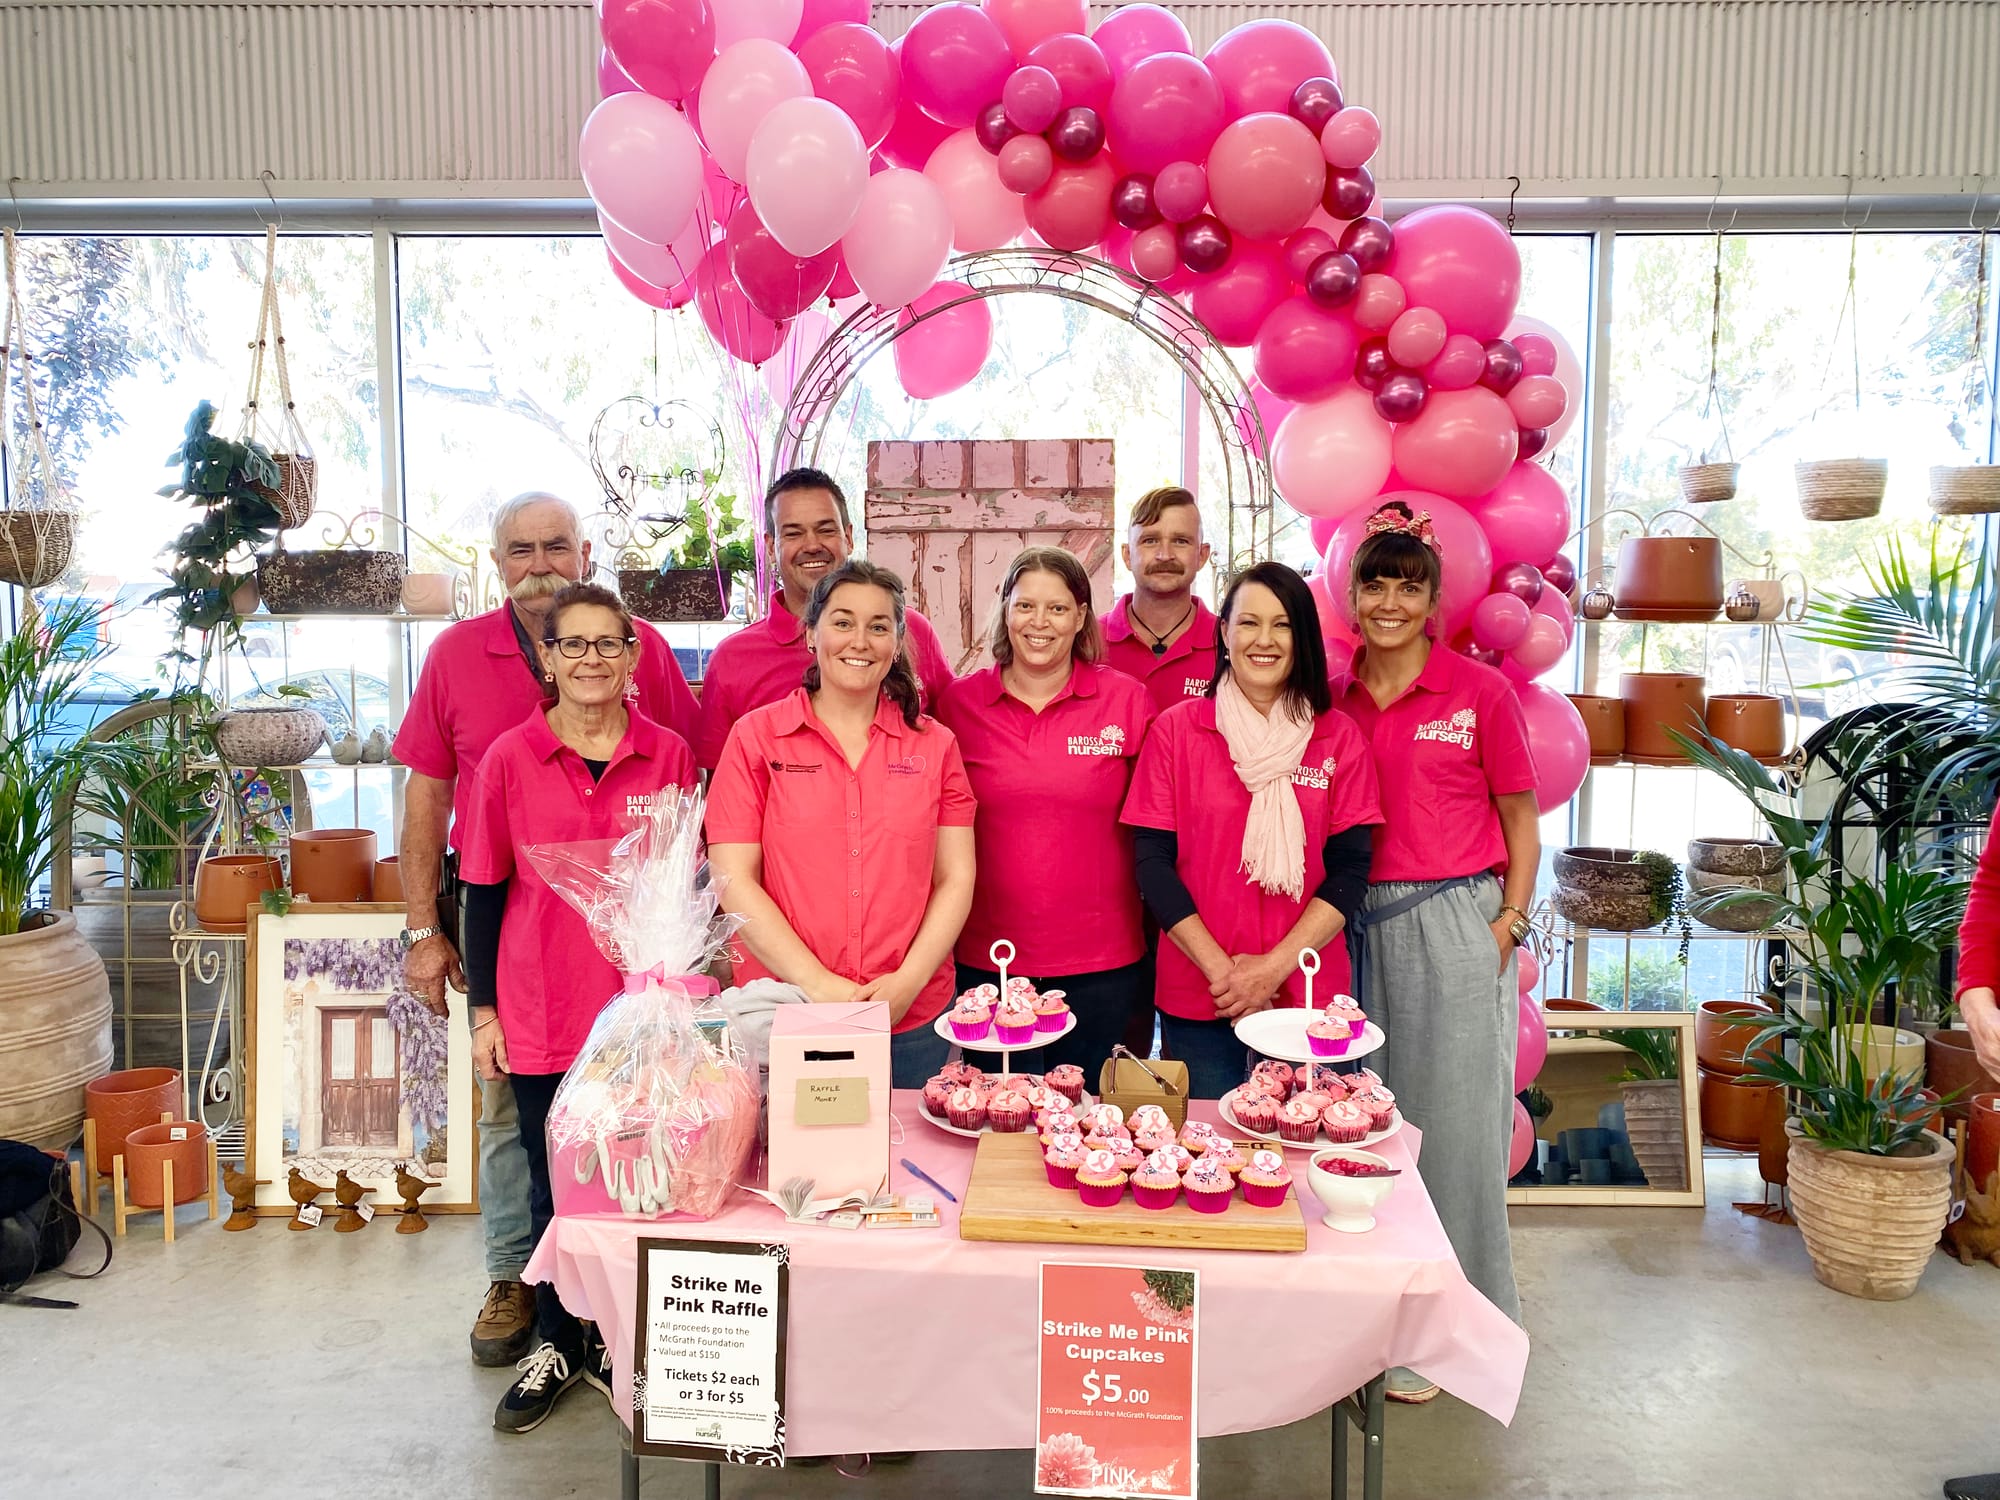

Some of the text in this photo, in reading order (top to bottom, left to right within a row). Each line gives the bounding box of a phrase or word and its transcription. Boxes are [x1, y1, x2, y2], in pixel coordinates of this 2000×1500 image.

[1184, 677, 1210, 688] BAROS
[1067, 736, 1104, 746] BAROSSA
[1413, 729, 1474, 750] nursery
[1296, 765, 1324, 778] ROSSA
[1291, 774, 1329, 789] nurse
[626, 795, 651, 806] BARO
[670, 1274, 762, 1294] Strike Me
[663, 1296, 768, 1317] Pink Raffle
[659, 1321, 750, 1336] All proceeds go to the
[1043, 1320, 1189, 1344] Strike Me Pink
[659, 1334, 745, 1349] McGrath Foundation
[658, 1347, 721, 1360] Valued at $150
[1066, 1344, 1165, 1364] Cupcakes
[664, 1368, 760, 1387] Tickets $2 each
[679, 1389, 744, 1404] or 3 for $5
[1065, 1408, 1094, 1417] proceeds
[1116, 1410, 1145, 1419] McGrath
[1146, 1412, 1184, 1421] Foundation
[1091, 1465, 1136, 1485] PINK
